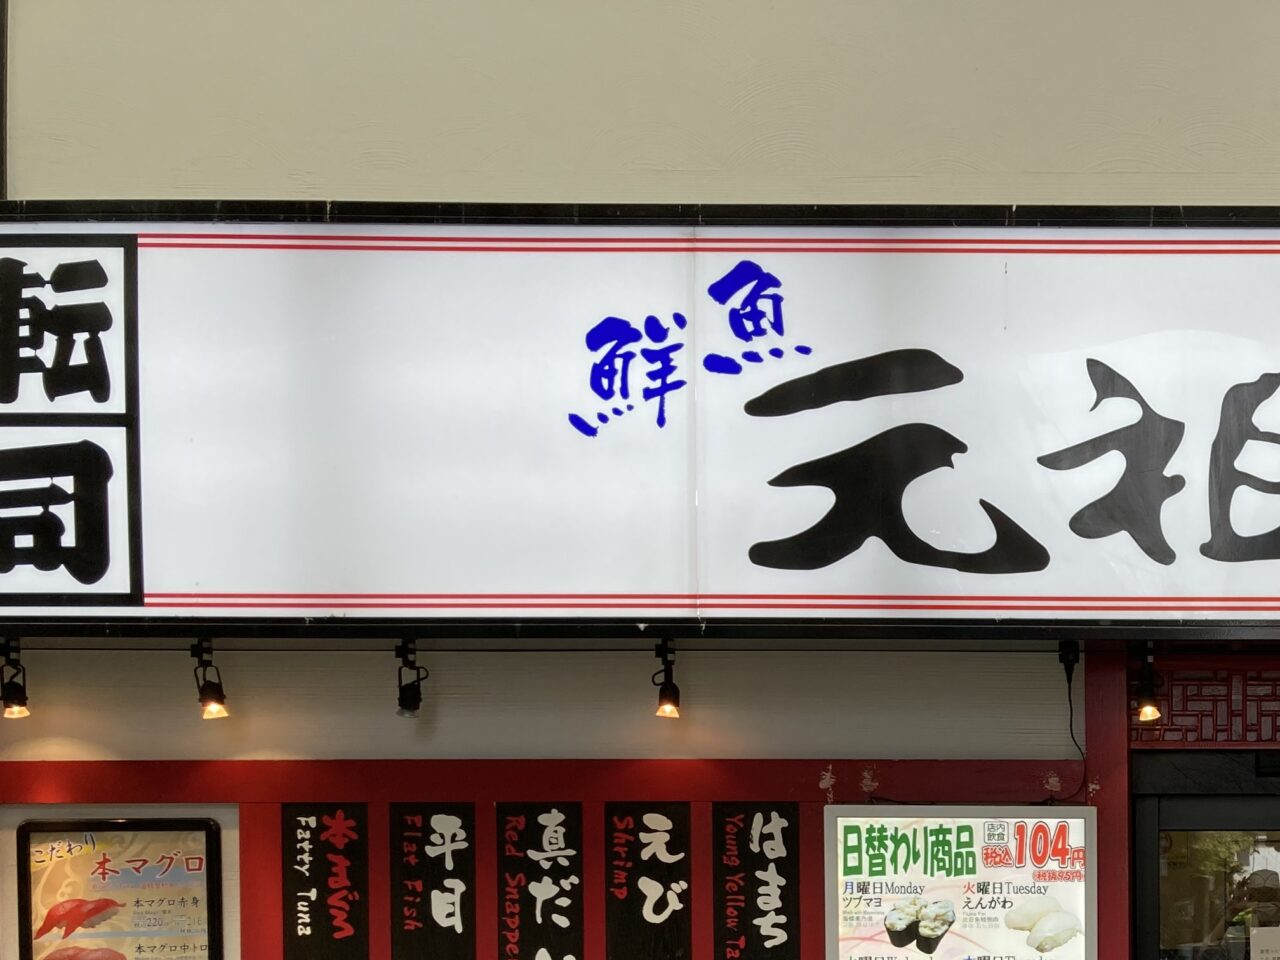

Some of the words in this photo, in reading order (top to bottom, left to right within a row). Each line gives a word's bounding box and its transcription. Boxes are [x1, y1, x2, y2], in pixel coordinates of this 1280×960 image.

[568, 259, 812, 437] 鮮魚
[34, 832, 97, 864] こだわり
[293, 815, 317, 877] Fatty
[403, 815, 422, 865] Flat
[504, 815, 526, 857] Red
[723, 814, 745, 867] Young
[843, 824, 977, 877] 日替わり商品
[987, 823, 1005, 832] 店内
[987, 833, 1005, 841] 飲食
[90, 851, 204, 881] 本マグロ
[425, 814, 469, 934] 平目
[610, 815, 634, 899] Shrimp
[637, 813, 688, 924] えび
[750, 811, 789, 949] はまち
[133, 896, 200, 908] 本マグロ赤身
[296, 888, 317, 936] Tuna
[403, 880, 423, 930] Fish
[724, 873, 746, 930] Yellow
[843, 896, 882, 908] ツブマヨ
[962, 896, 1013, 909] えんがわ
[135, 943, 208, 955] 本マグロ中トロ
